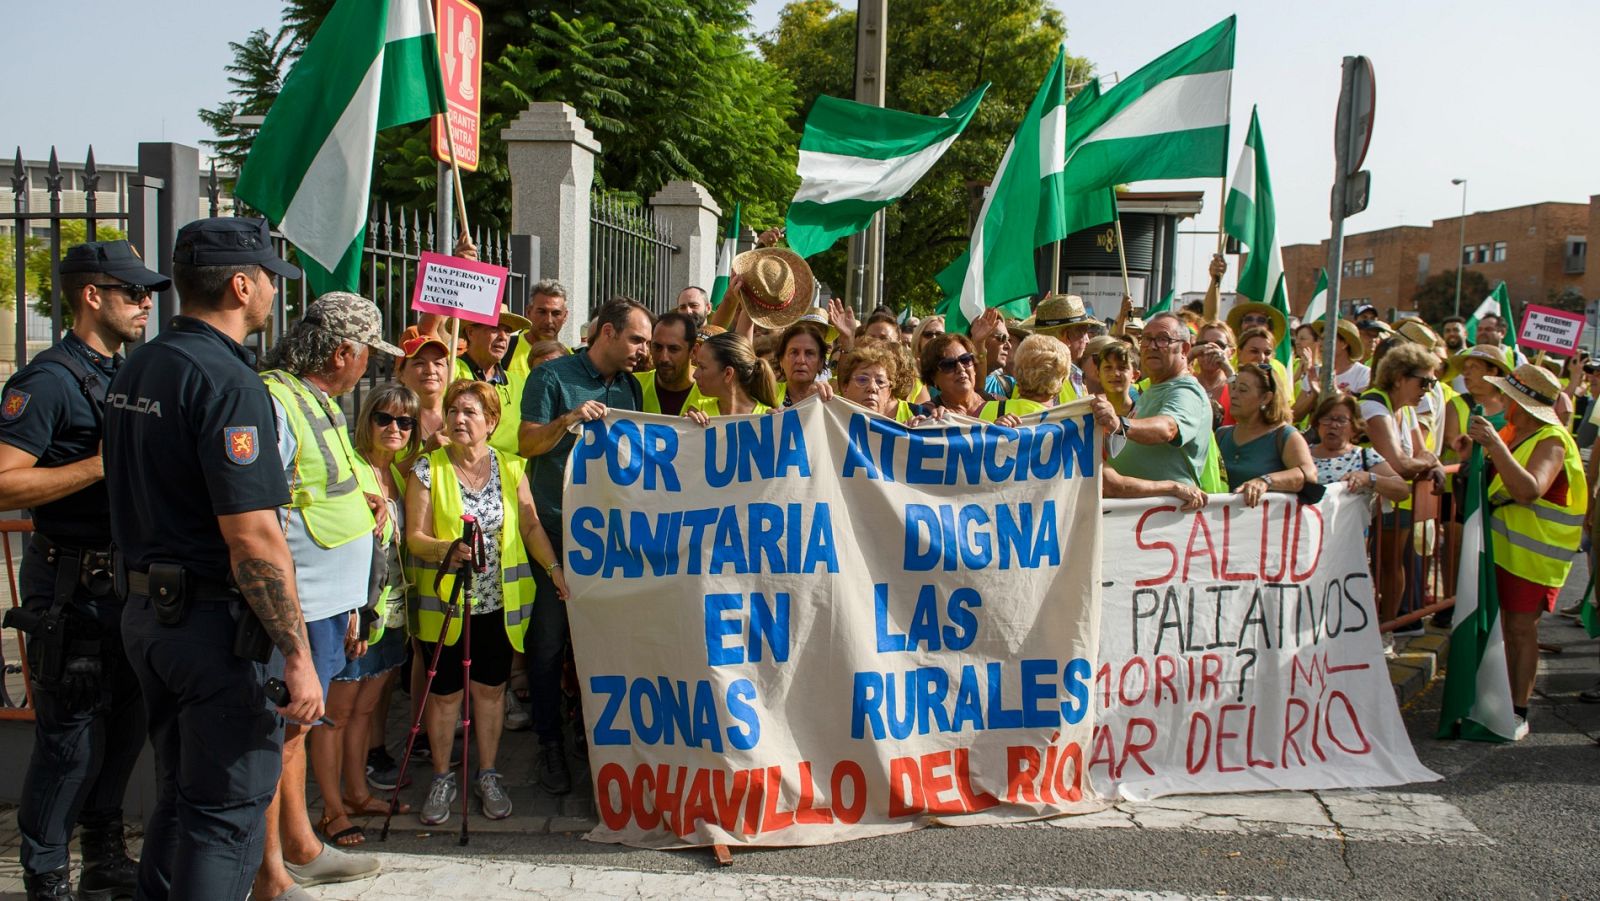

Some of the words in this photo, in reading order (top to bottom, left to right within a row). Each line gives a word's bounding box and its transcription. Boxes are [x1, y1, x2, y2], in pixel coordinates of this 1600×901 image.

[447, 109, 476, 132] DRANTE
[450, 126, 473, 145] ONTRA
[423, 294, 464, 308] EXCUSAS
[425, 285, 459, 296] MENOS
[427, 275, 477, 291] SANITARIO
[449, 269, 497, 286] PERSONAL
[572, 418, 682, 492] POR
[704, 409, 812, 488] UNA
[842, 411, 1095, 485] ATENCIÓN
[568, 501, 840, 579] SANITARIA
[903, 500, 1061, 572] DIGNA
[1135, 499, 1325, 588] SALUD
[704, 592, 791, 667] EN
[874, 583, 983, 654] LAS
[1132, 573, 1369, 655] PALIATIVOS
[589, 675, 761, 754] ZONAS
[851, 658, 1092, 741] RURALES
[1088, 717, 1156, 782] AR
[1185, 703, 1275, 776] DEL
[597, 759, 867, 838] OCHAVILLO
[888, 747, 1000, 818] DEL
[1006, 731, 1083, 805] RÍO
